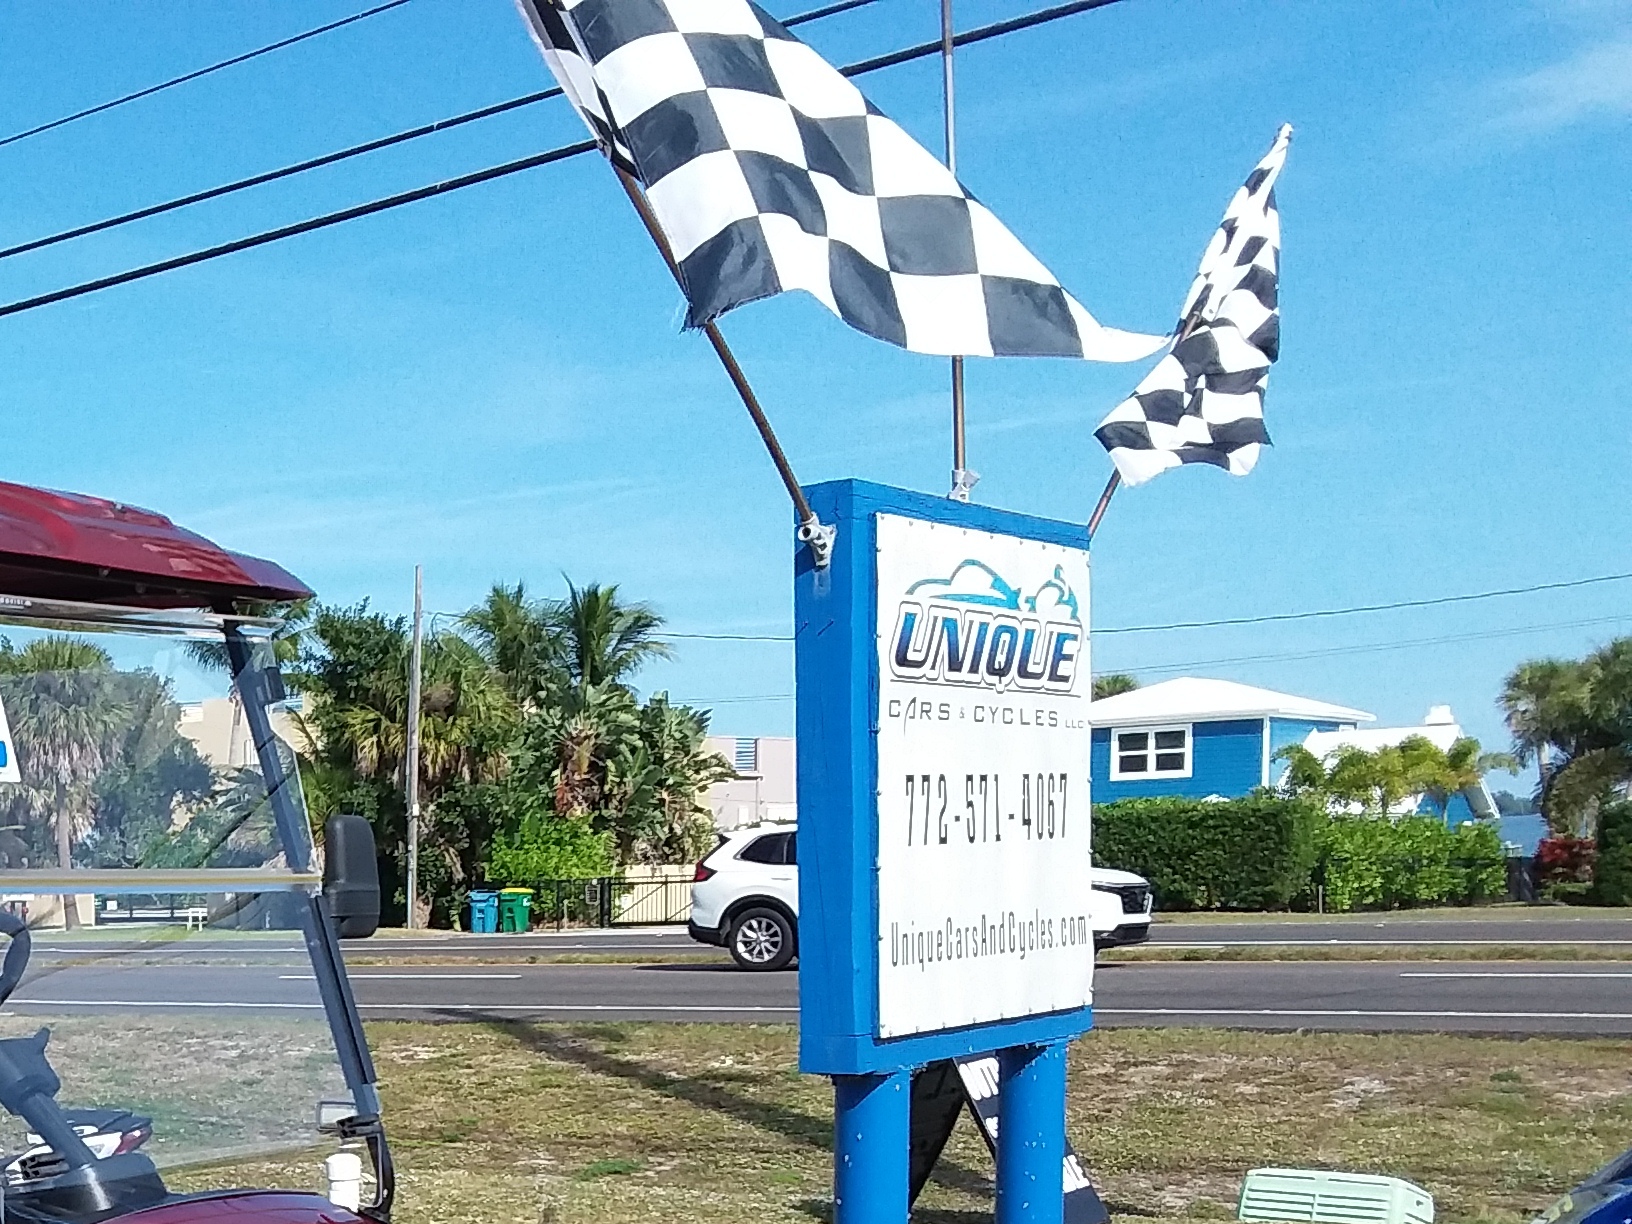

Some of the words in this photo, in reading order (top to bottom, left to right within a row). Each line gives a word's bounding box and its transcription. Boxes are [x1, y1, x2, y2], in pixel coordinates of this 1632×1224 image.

[893, 611, 1079, 685] UNIQUE
[888, 697, 951, 735] CARS
[958, 706, 966, 720] &
[973, 705, 1059, 728] CYCLES
[1064, 719, 1084, 729] LLC
[905, 773, 1068, 847] 772-571-4067
[891, 908, 1088, 972] UniqueCarsAndCycles.com
